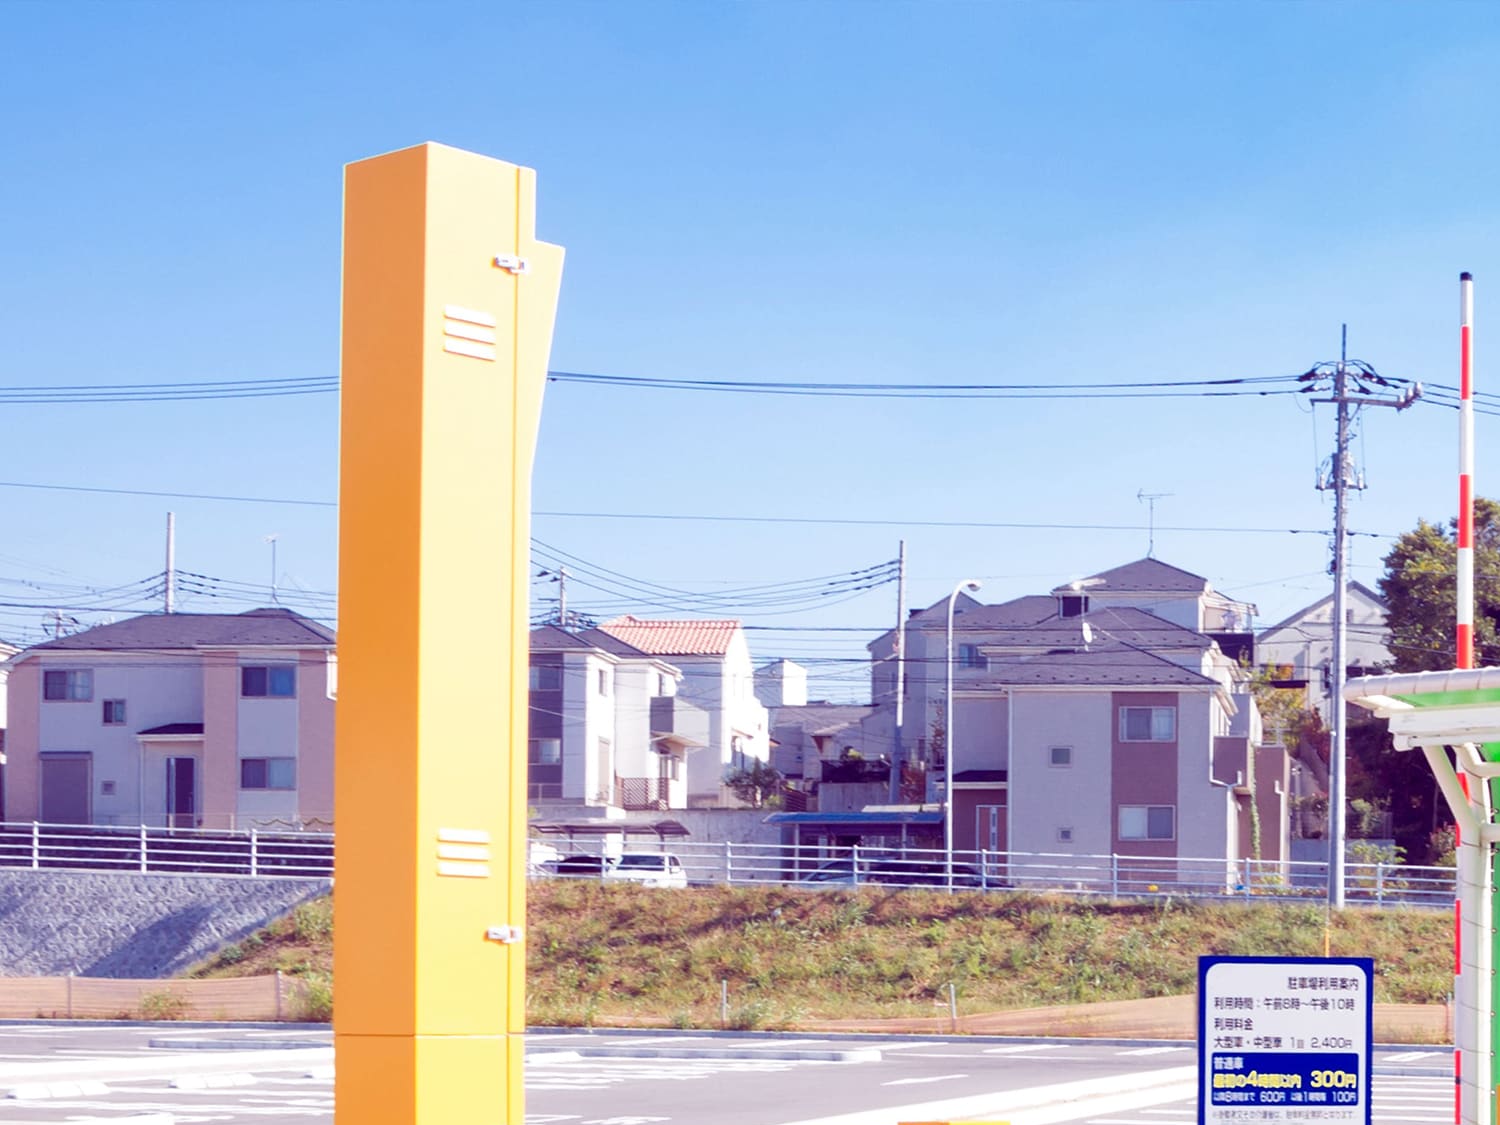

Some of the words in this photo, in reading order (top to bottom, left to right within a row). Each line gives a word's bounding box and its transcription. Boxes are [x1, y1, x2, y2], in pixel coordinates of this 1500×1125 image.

[1287, 976, 1359, 991] 駐車場利用案内
[1213, 1018, 1254, 1031] 利用料金
[1310, 1070, 1357, 1089] 300円
[1260, 1091, 1286, 1103] 600円
[1332, 1091, 1357, 1103] 100円
